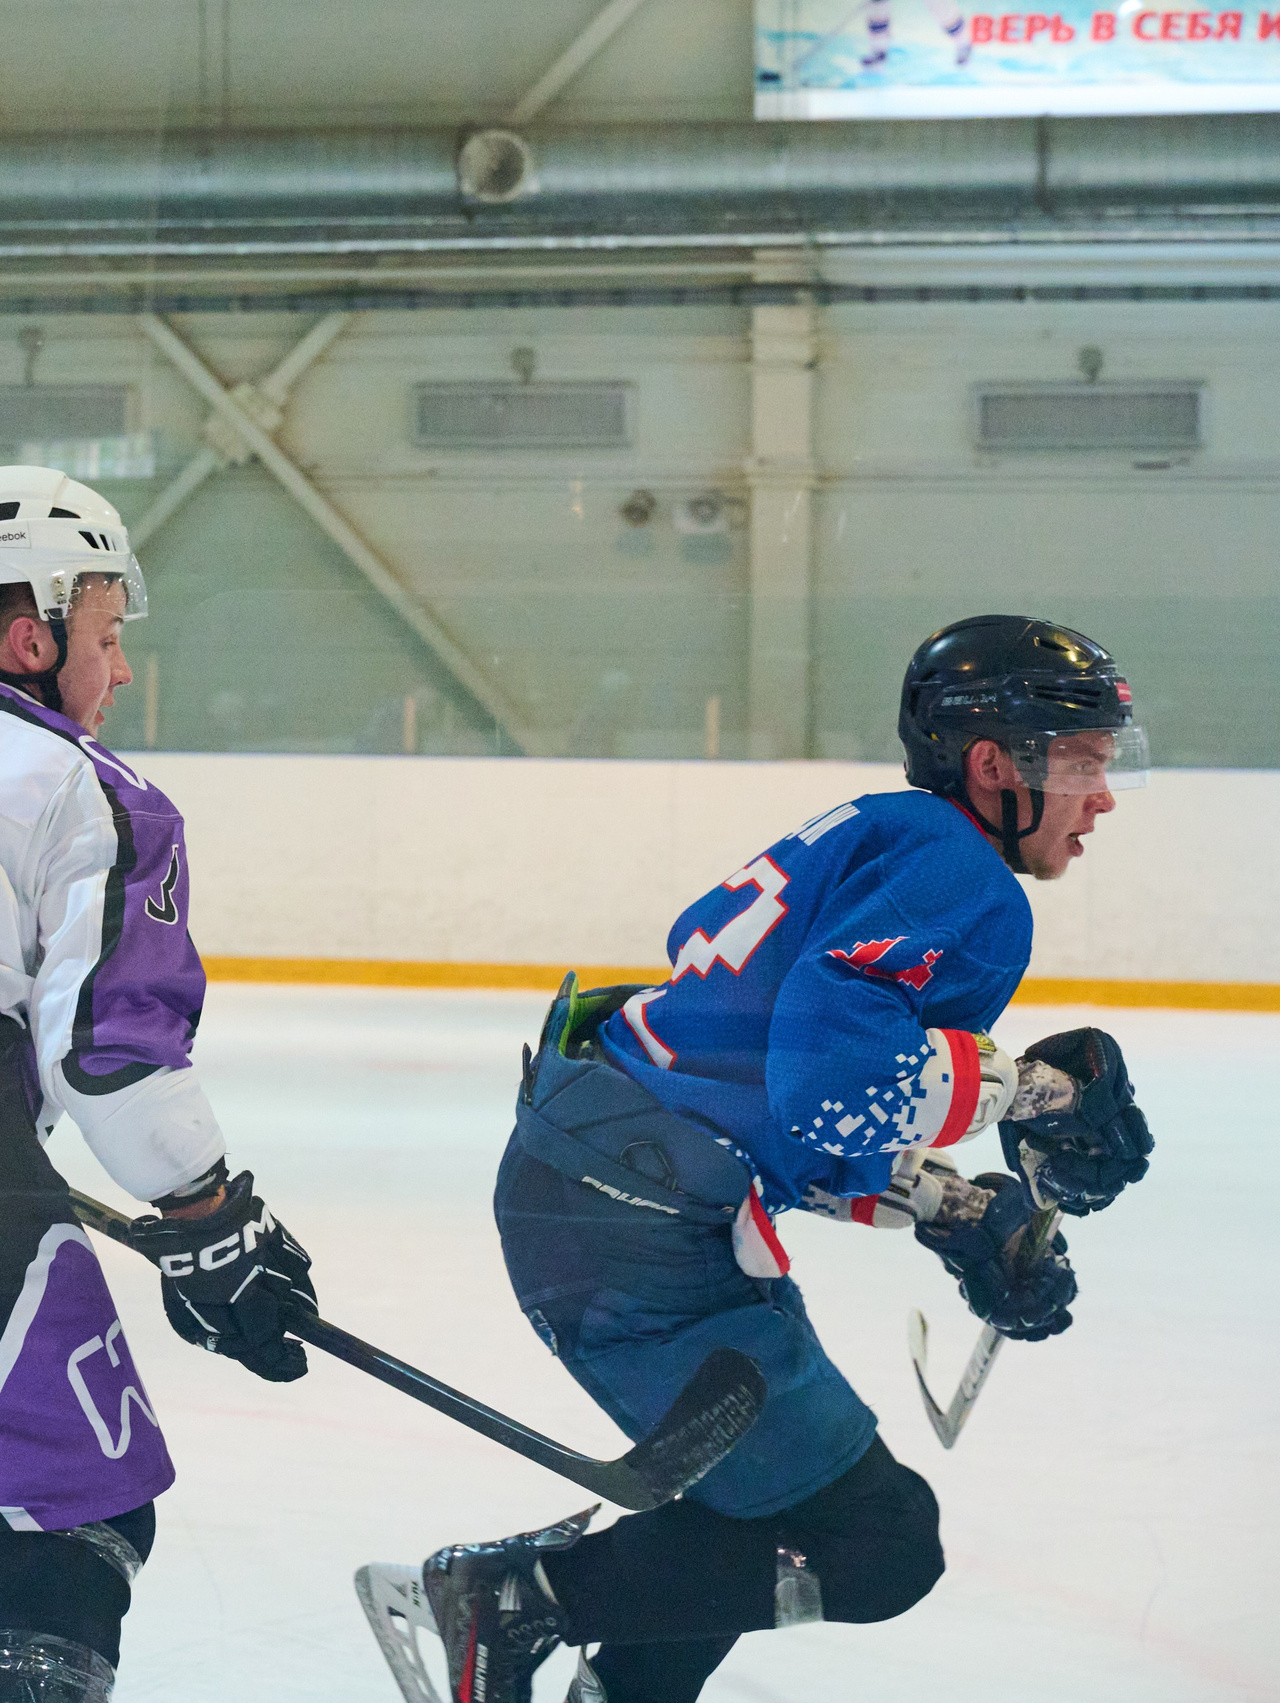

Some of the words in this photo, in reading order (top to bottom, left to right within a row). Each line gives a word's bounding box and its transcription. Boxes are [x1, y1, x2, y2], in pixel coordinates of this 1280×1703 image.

[970, 13, 1076, 44] ВЕРЬ
[1090, 11, 1116, 42] В
[1131, 11, 1243, 42] СЕБЯ
[159, 1204, 276, 1278] CCM
